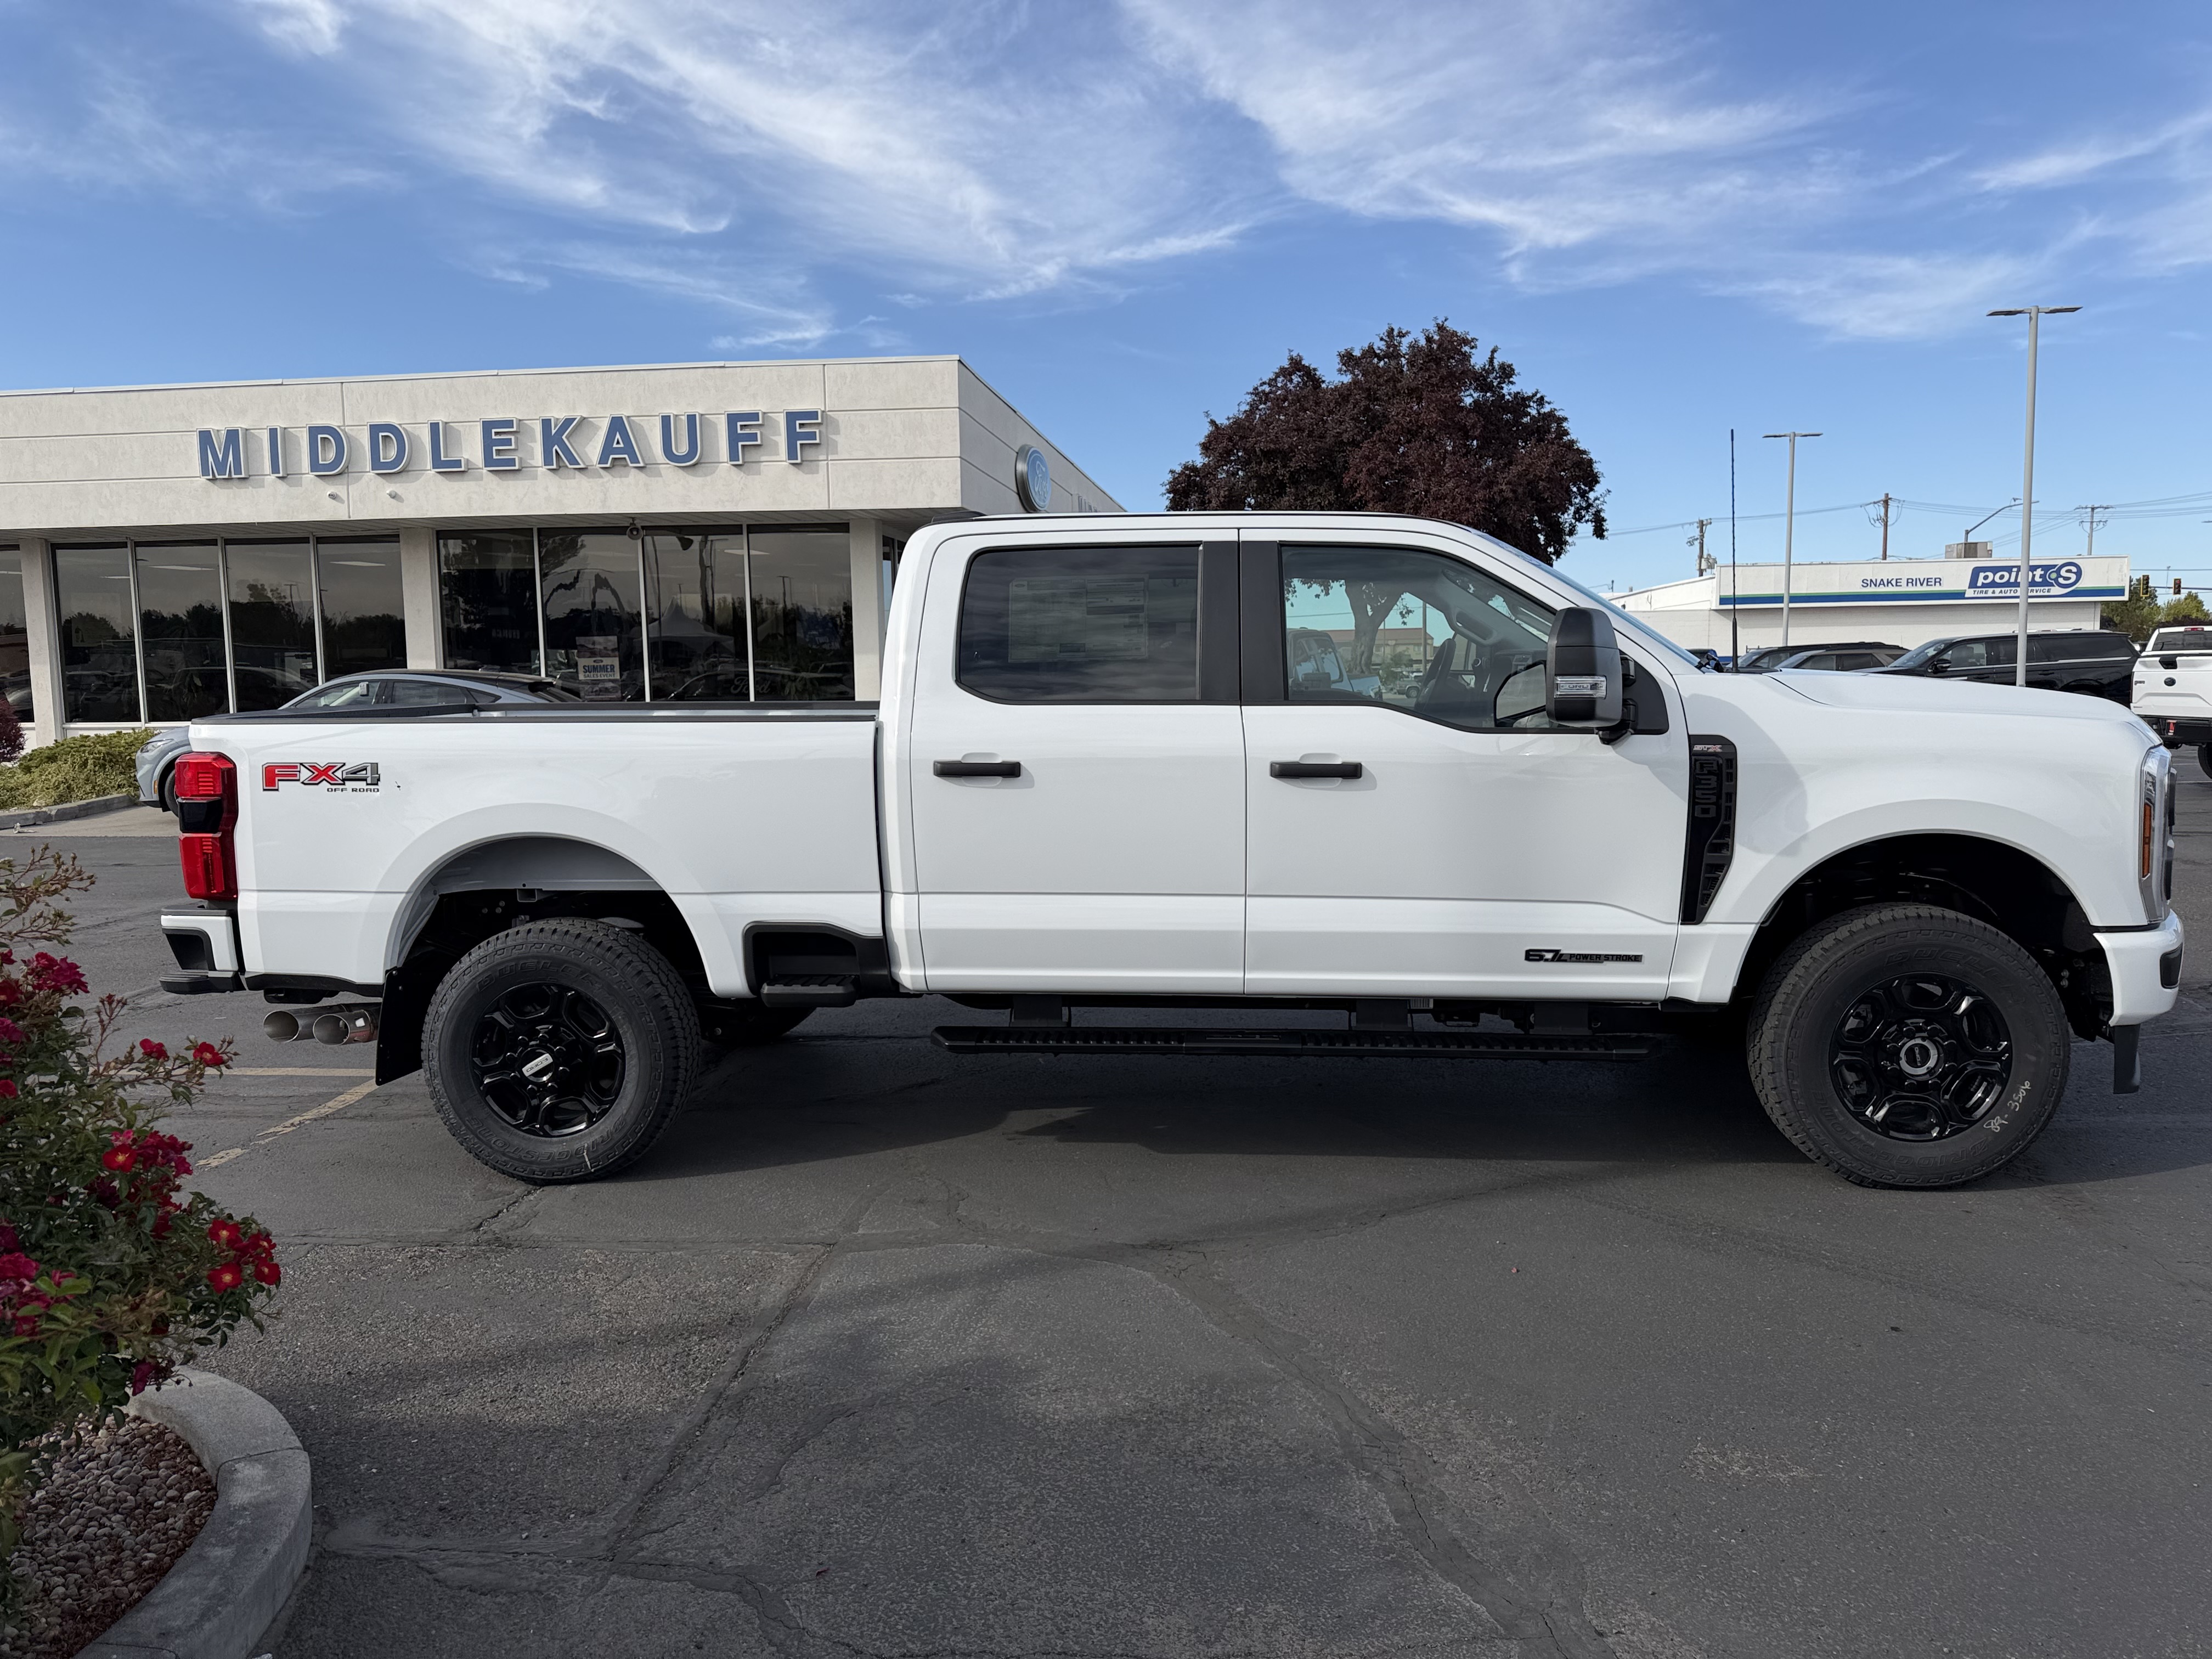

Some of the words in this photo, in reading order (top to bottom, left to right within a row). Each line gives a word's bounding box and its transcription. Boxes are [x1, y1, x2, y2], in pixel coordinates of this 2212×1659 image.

[196, 409, 825, 479] MIDDLEKAUFF
[1034, 460, 1049, 499] Ford
[1861, 578, 1903, 588] SNAKE
[1906, 577, 1942, 587] RIVER
[583, 664, 615, 674] SUMMER
[262, 763, 380, 791] FX4
[476, 960, 604, 992] DUELER
[526, 1058, 549, 1073] FORD
[465, 1115, 627, 1162] BRIDGESTONE
[1812, 1089, 1989, 1169] BRIDGESTONE
